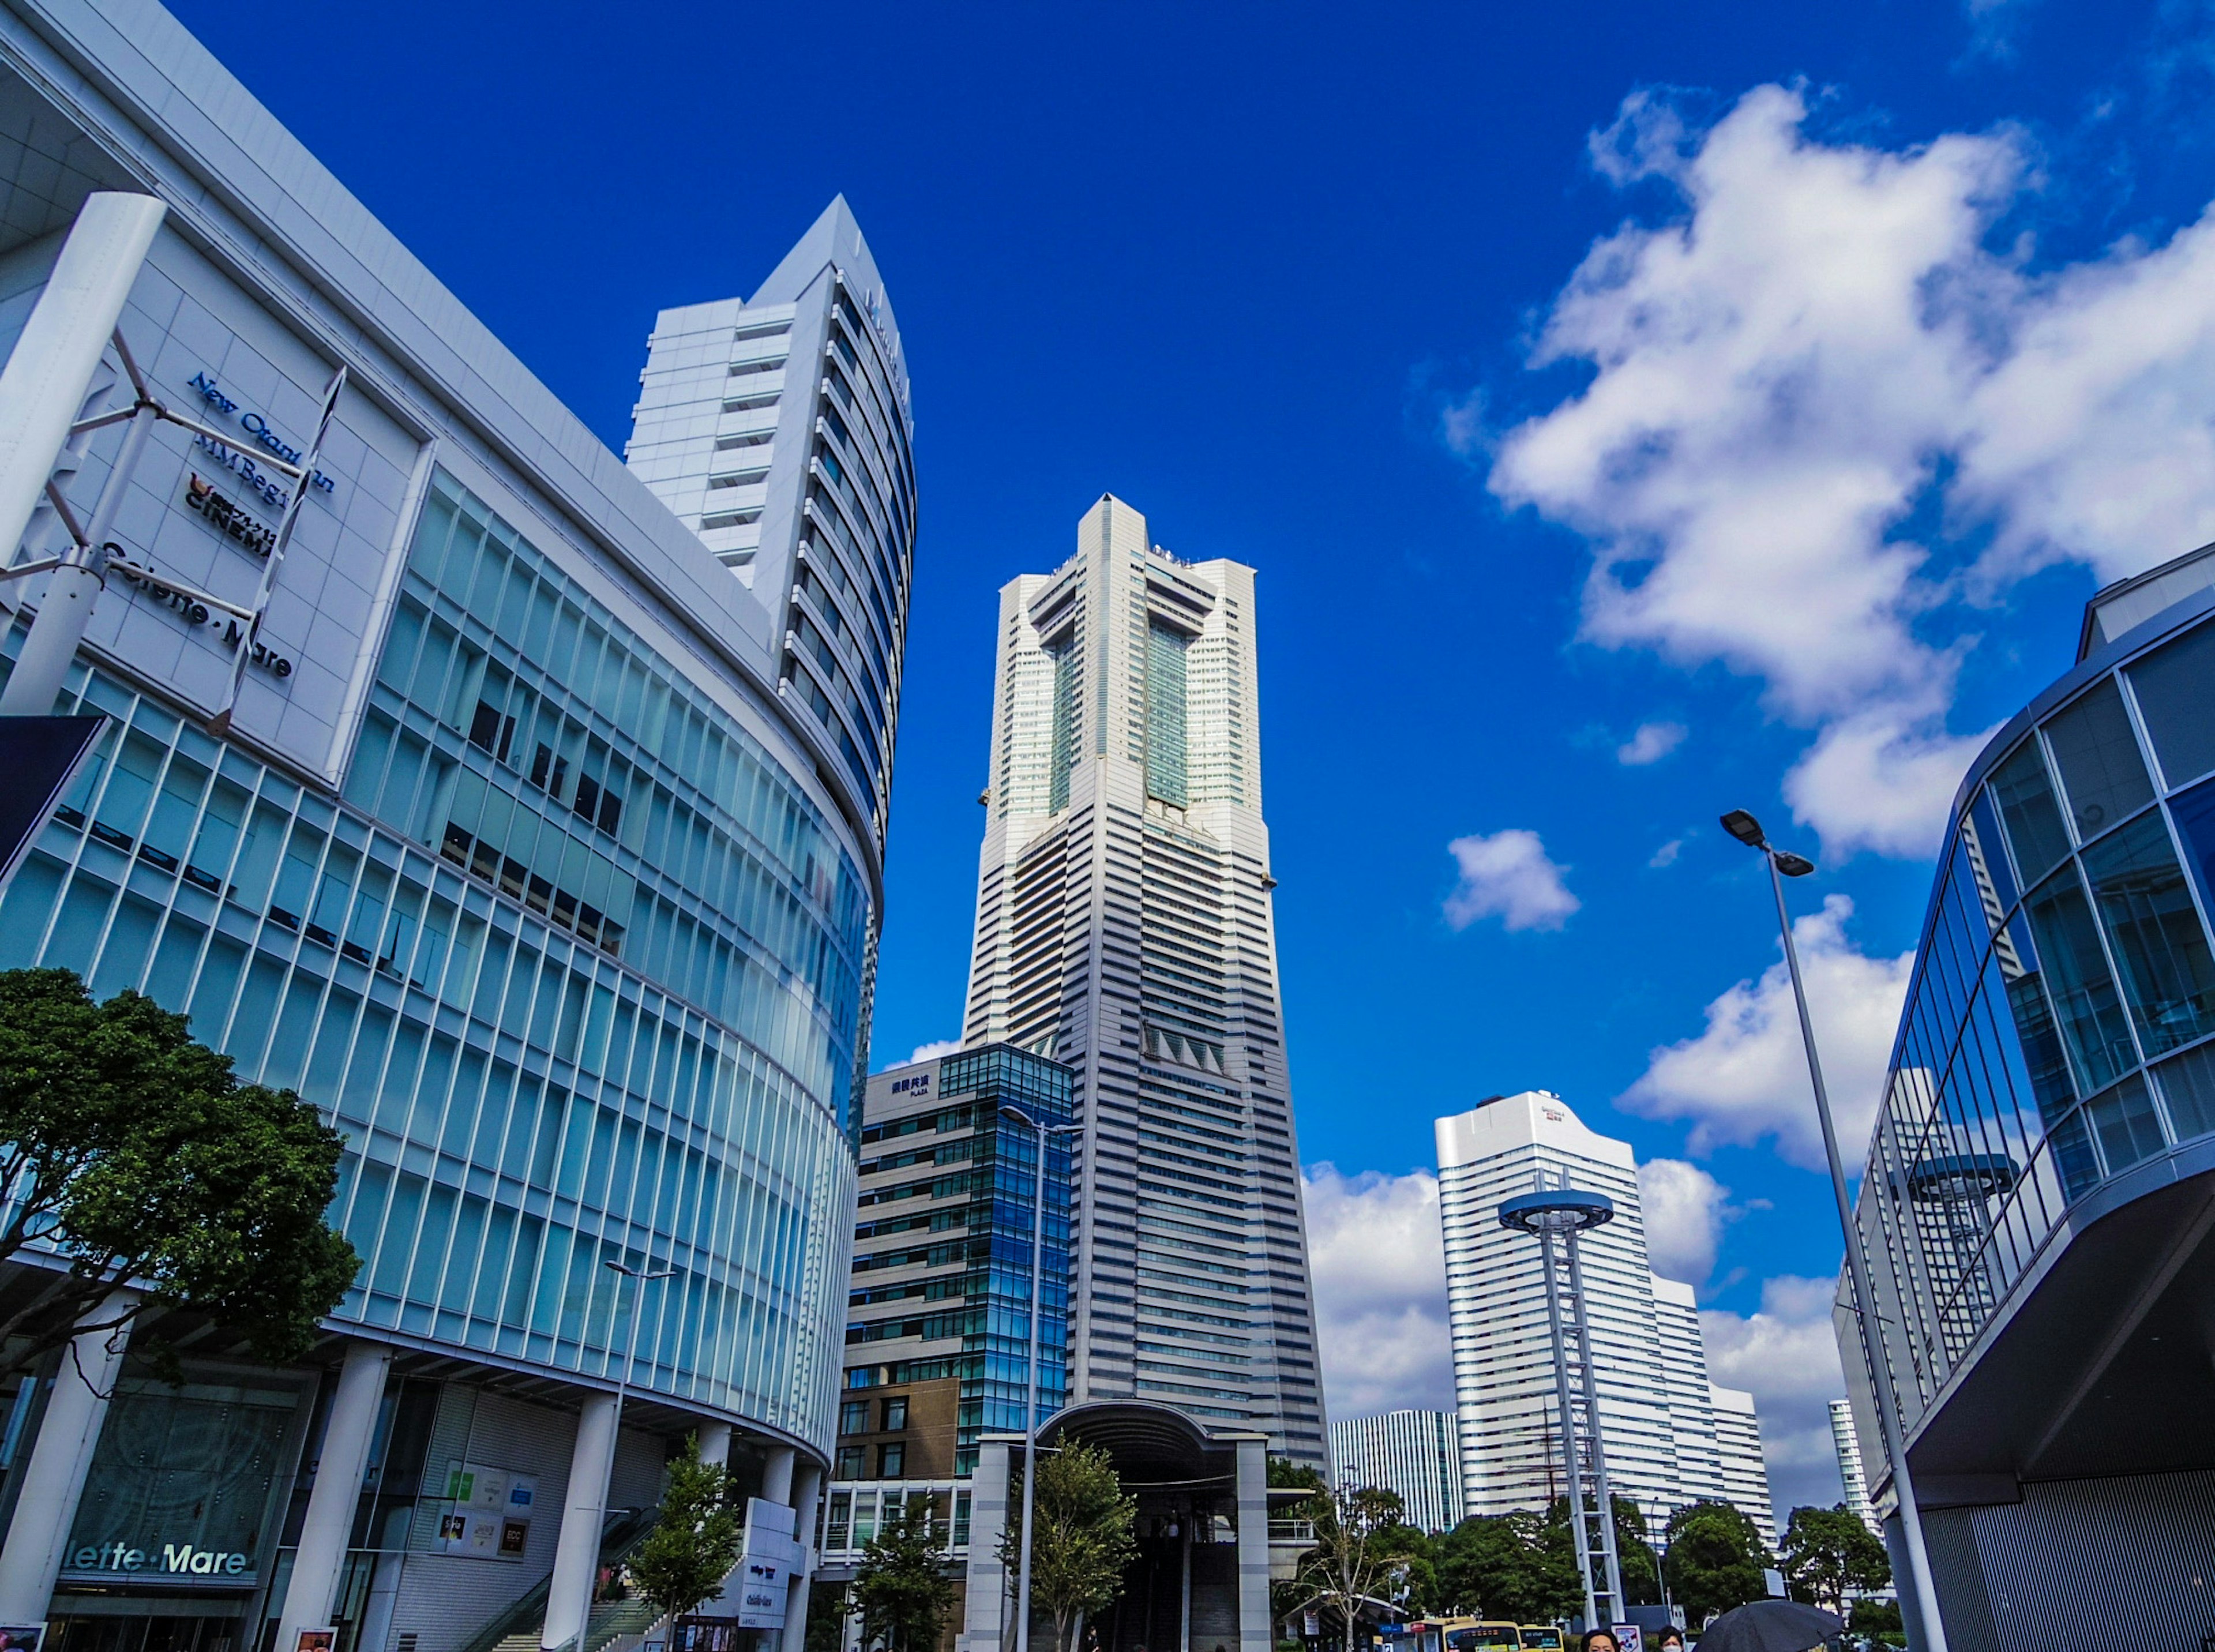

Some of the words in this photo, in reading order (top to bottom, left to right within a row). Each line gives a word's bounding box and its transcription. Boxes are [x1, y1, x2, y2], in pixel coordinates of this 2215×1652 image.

[186, 371, 239, 414] New
[241, 413, 302, 465] Otani
[237, 457, 290, 510] Begi
